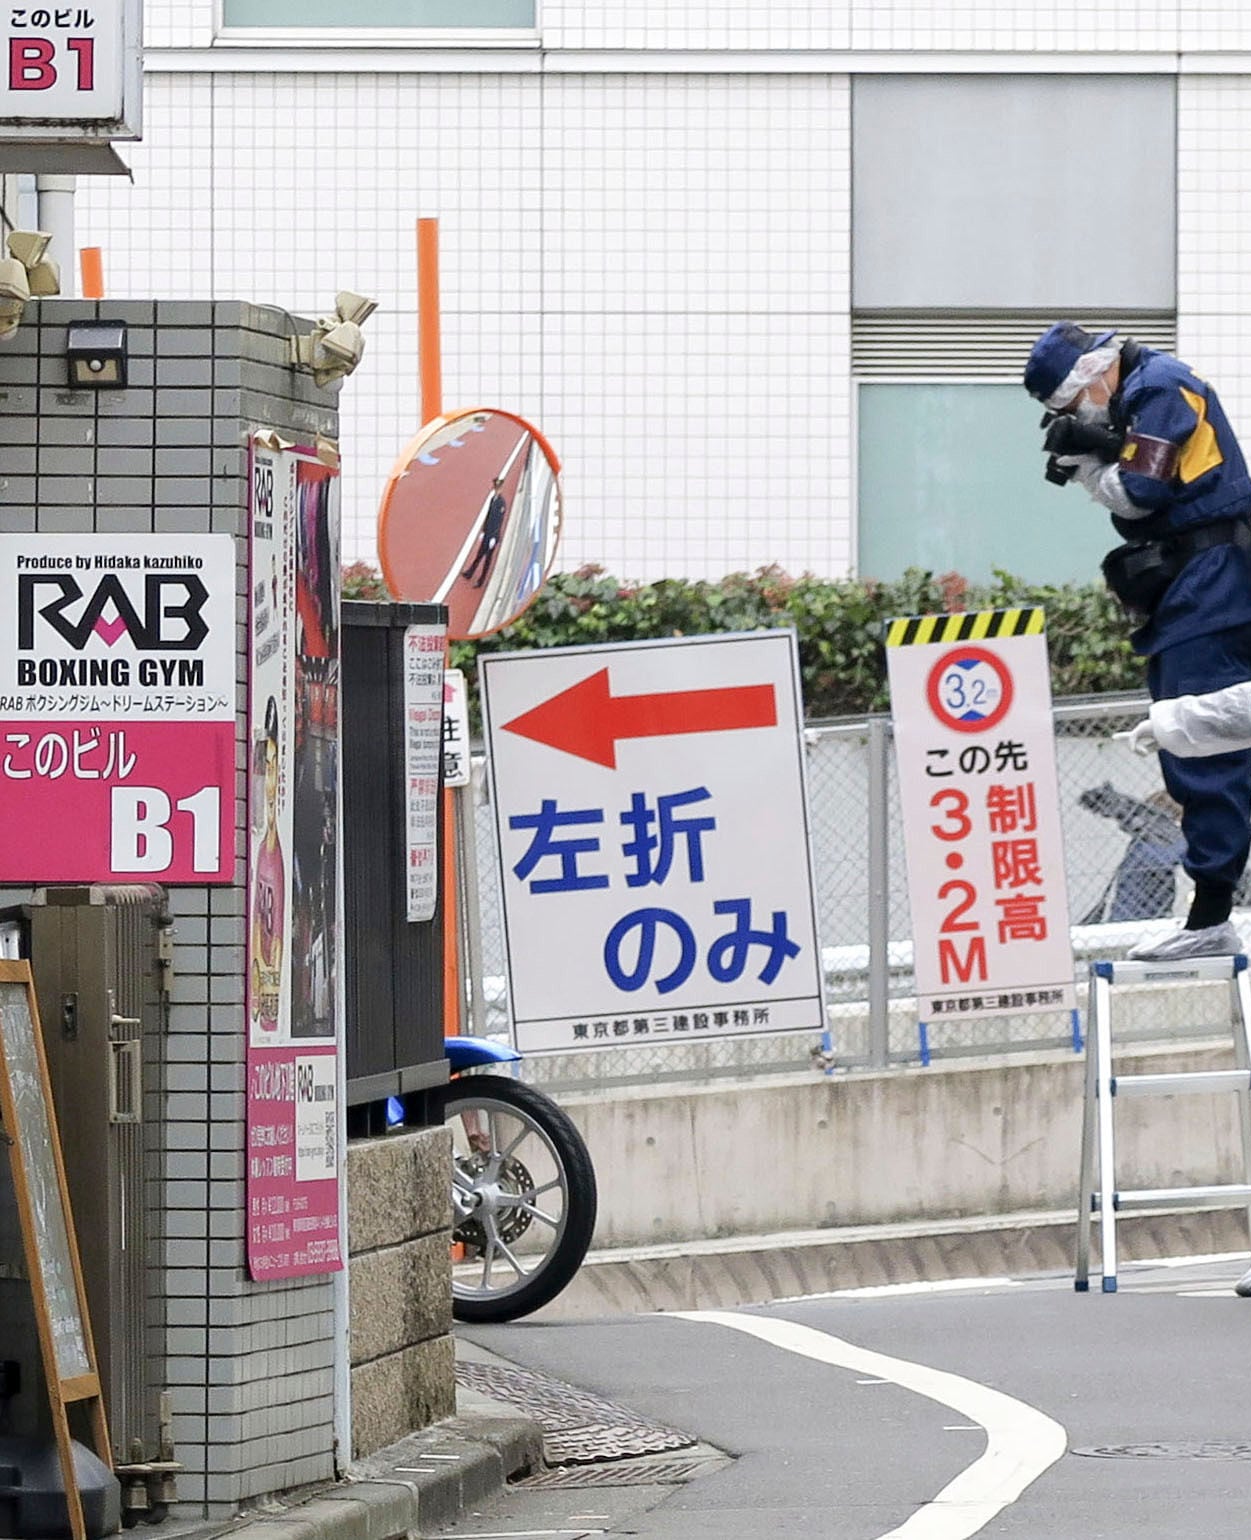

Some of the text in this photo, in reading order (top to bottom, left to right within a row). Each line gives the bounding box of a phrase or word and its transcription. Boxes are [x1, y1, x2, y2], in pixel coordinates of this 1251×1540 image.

[11, 8, 94, 28] このビル
[8, 37, 94, 91] B1
[17, 555, 203, 570] Produce by Hidaka kazuhiko
[18, 574, 210, 650] RAB
[18, 659, 204, 686] BOXING GYM
[3, 727, 137, 780] このビル
[925, 740, 1029, 776] この先
[110, 786, 220, 873] B1
[508, 786, 717, 894] 左折
[986, 782, 1047, 944] 制限高
[603, 897, 801, 995] のみ
[573, 1007, 770, 1040] 東京都第三建設事務所
